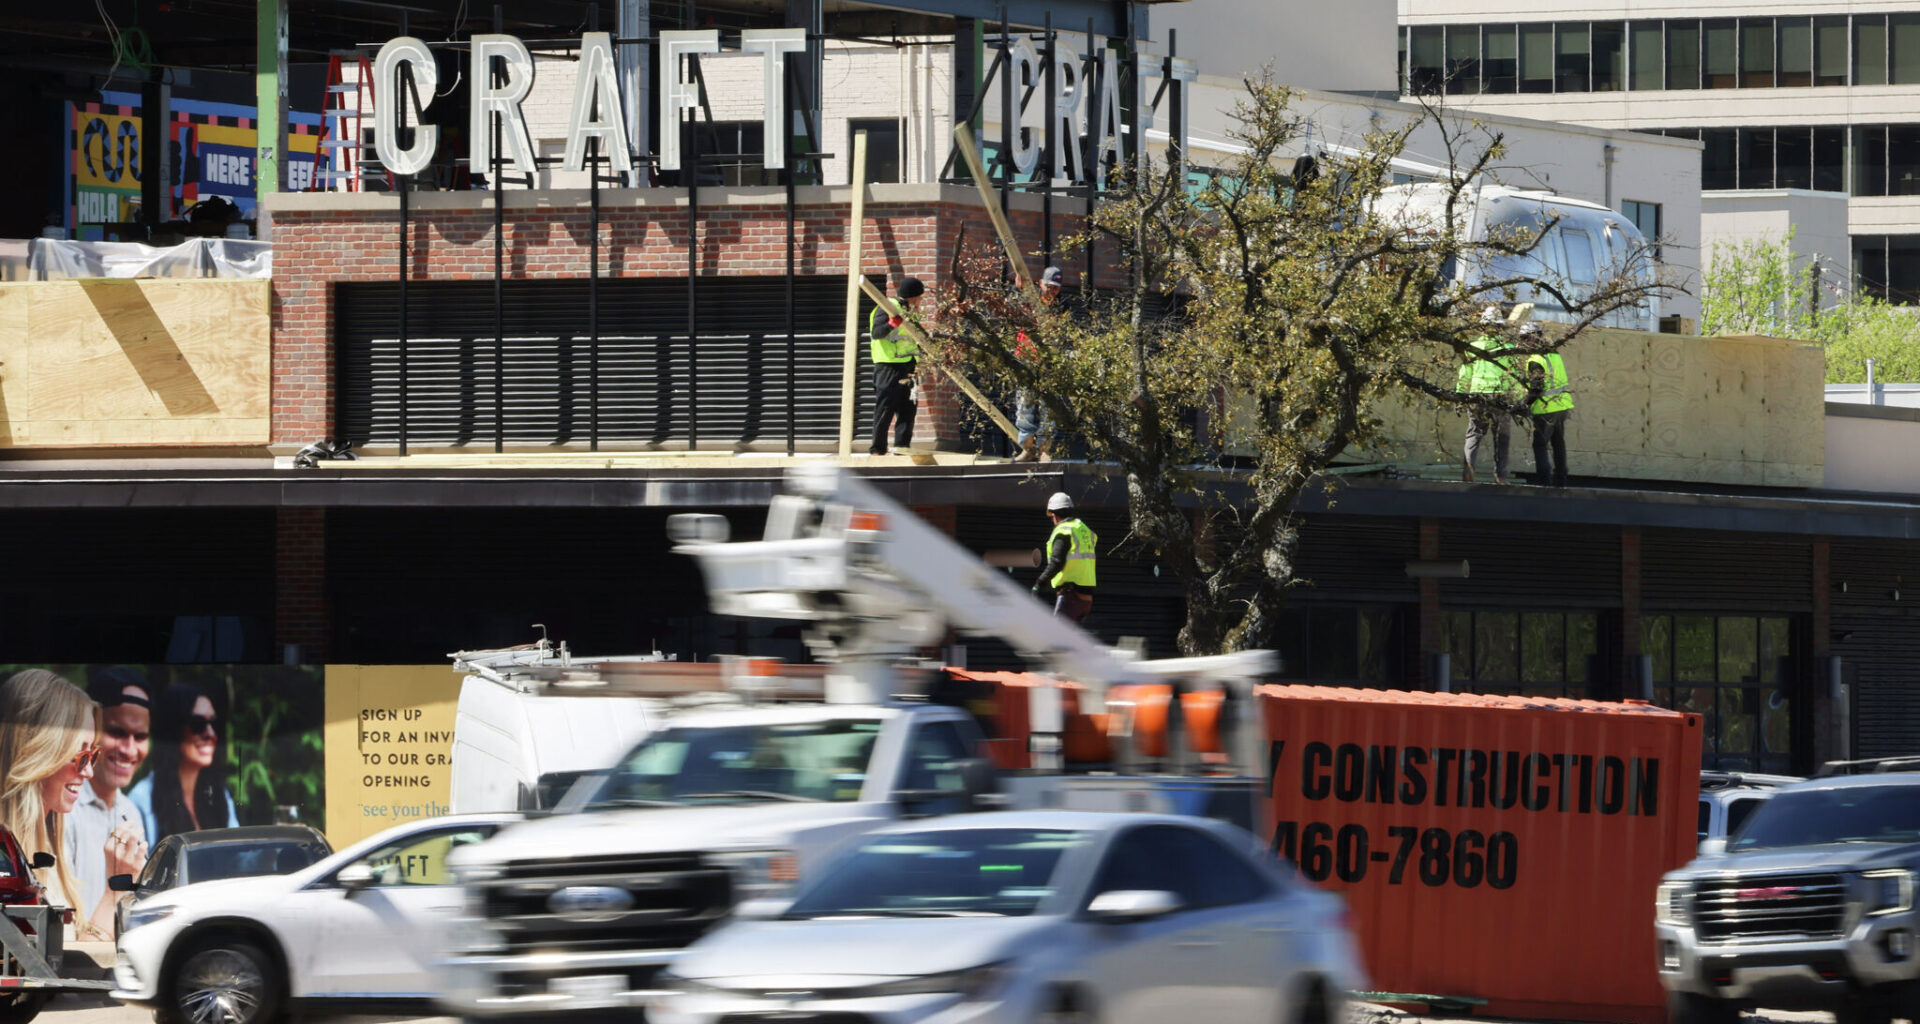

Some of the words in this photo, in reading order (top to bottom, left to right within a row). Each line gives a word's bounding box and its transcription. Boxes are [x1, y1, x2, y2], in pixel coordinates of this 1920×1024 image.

[374, 28, 807, 175] CRAFT
[1009, 37, 1198, 191] CRAFT
[206, 153, 249, 186] HERE
[78, 191, 118, 223] HOLA
[361, 709, 398, 721] SIGN
[404, 709, 422, 721] UP
[361, 731, 391, 743] FOR
[398, 731, 418, 743] AN
[362, 753, 382, 765] TO
[388, 753, 419, 765] OUR
[362, 775, 431, 787] OPENING
[1301, 741, 1660, 816] CONSTRUCTION
[362, 804, 388, 817] see
[391, 804, 421, 821] you
[1268, 821, 1518, 889] 460-7860
